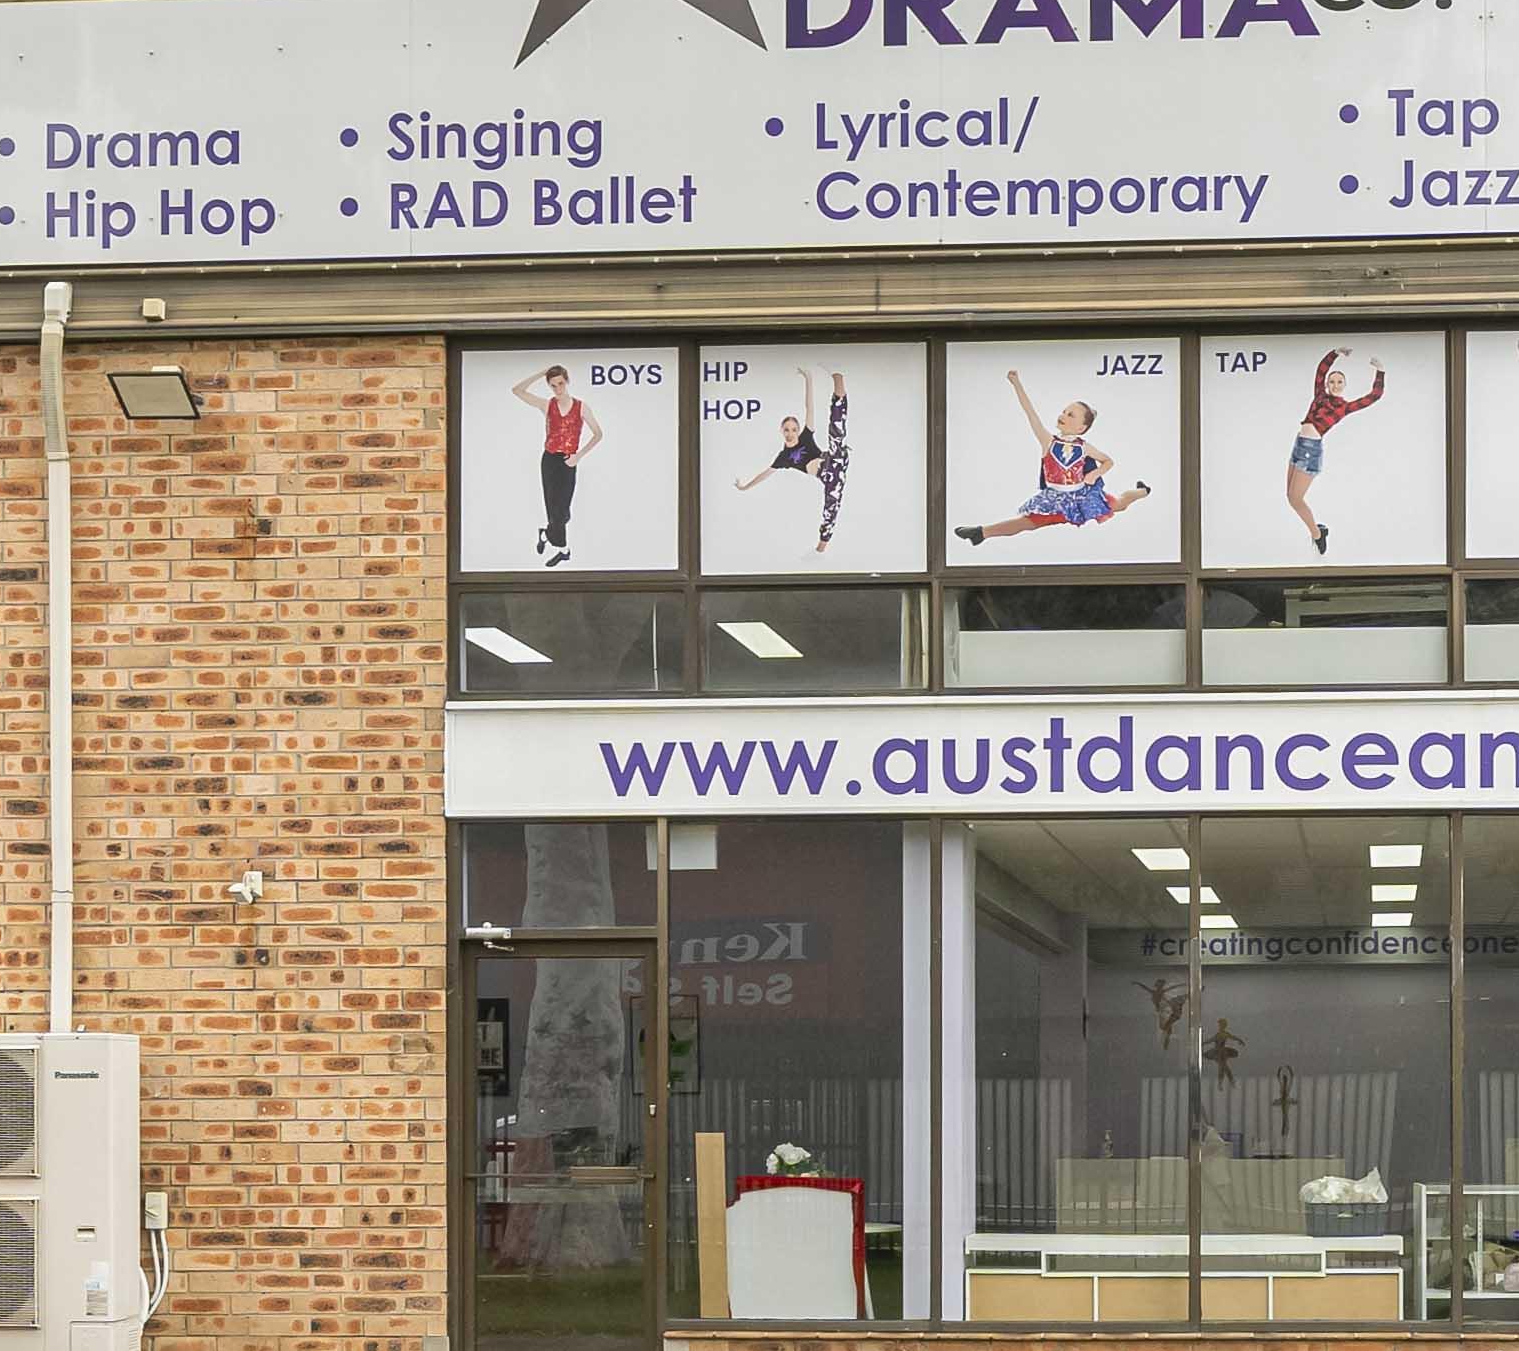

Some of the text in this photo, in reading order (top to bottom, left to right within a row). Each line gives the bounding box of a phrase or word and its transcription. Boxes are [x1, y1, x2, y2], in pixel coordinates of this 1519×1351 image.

[387, 109, 603, 169] Singing
[817, 96, 1040, 161] Lyrical/
[1388, 89, 1499, 147] Tap
[47, 124, 239, 169] Drama
[47, 189, 275, 249] Hip Hop
[391, 173, 697, 229] RAD Ballet
[817, 169, 1269, 227] Contemporary
[591, 364, 662, 385] BOYS
[704, 362, 748, 382] HIP
[1097, 354, 1163, 375] JAZZ
[1215, 352, 1267, 372] TAP
[703, 400, 761, 420] HOP
